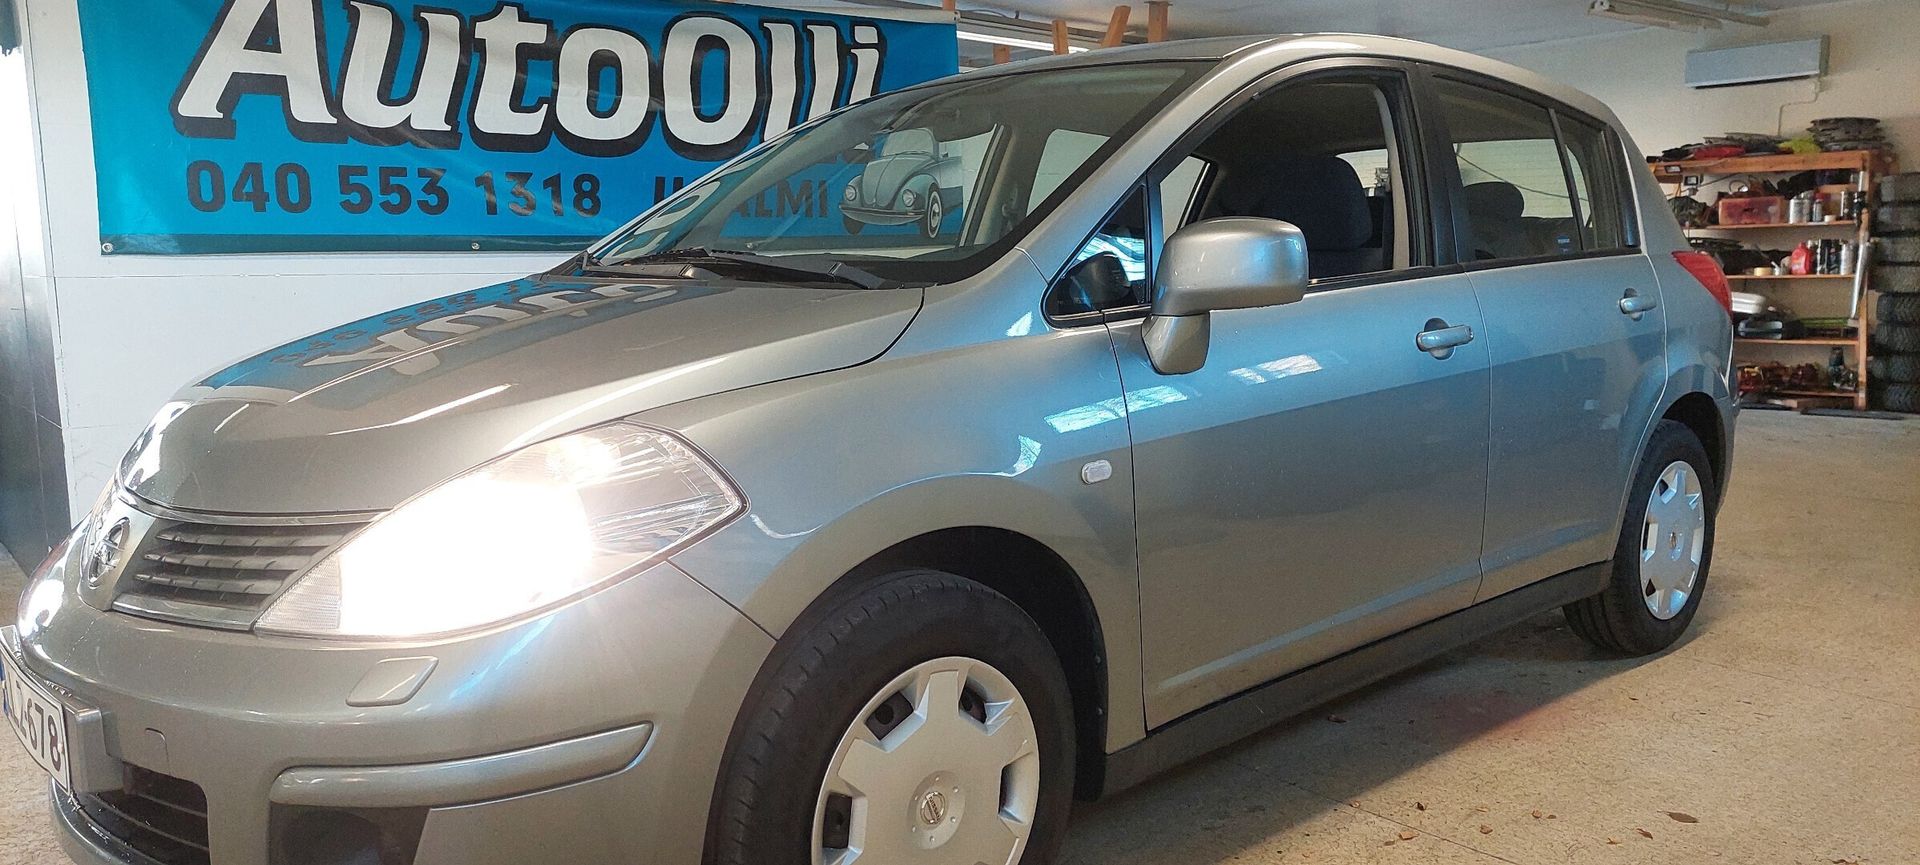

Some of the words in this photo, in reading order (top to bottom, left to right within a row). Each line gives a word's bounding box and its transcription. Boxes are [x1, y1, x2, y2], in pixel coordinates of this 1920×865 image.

[174, 0, 884, 148] AutoOlli
[186, 160, 312, 214] 040
[338, 165, 450, 215] 553
[474, 171, 602, 216] 1318
